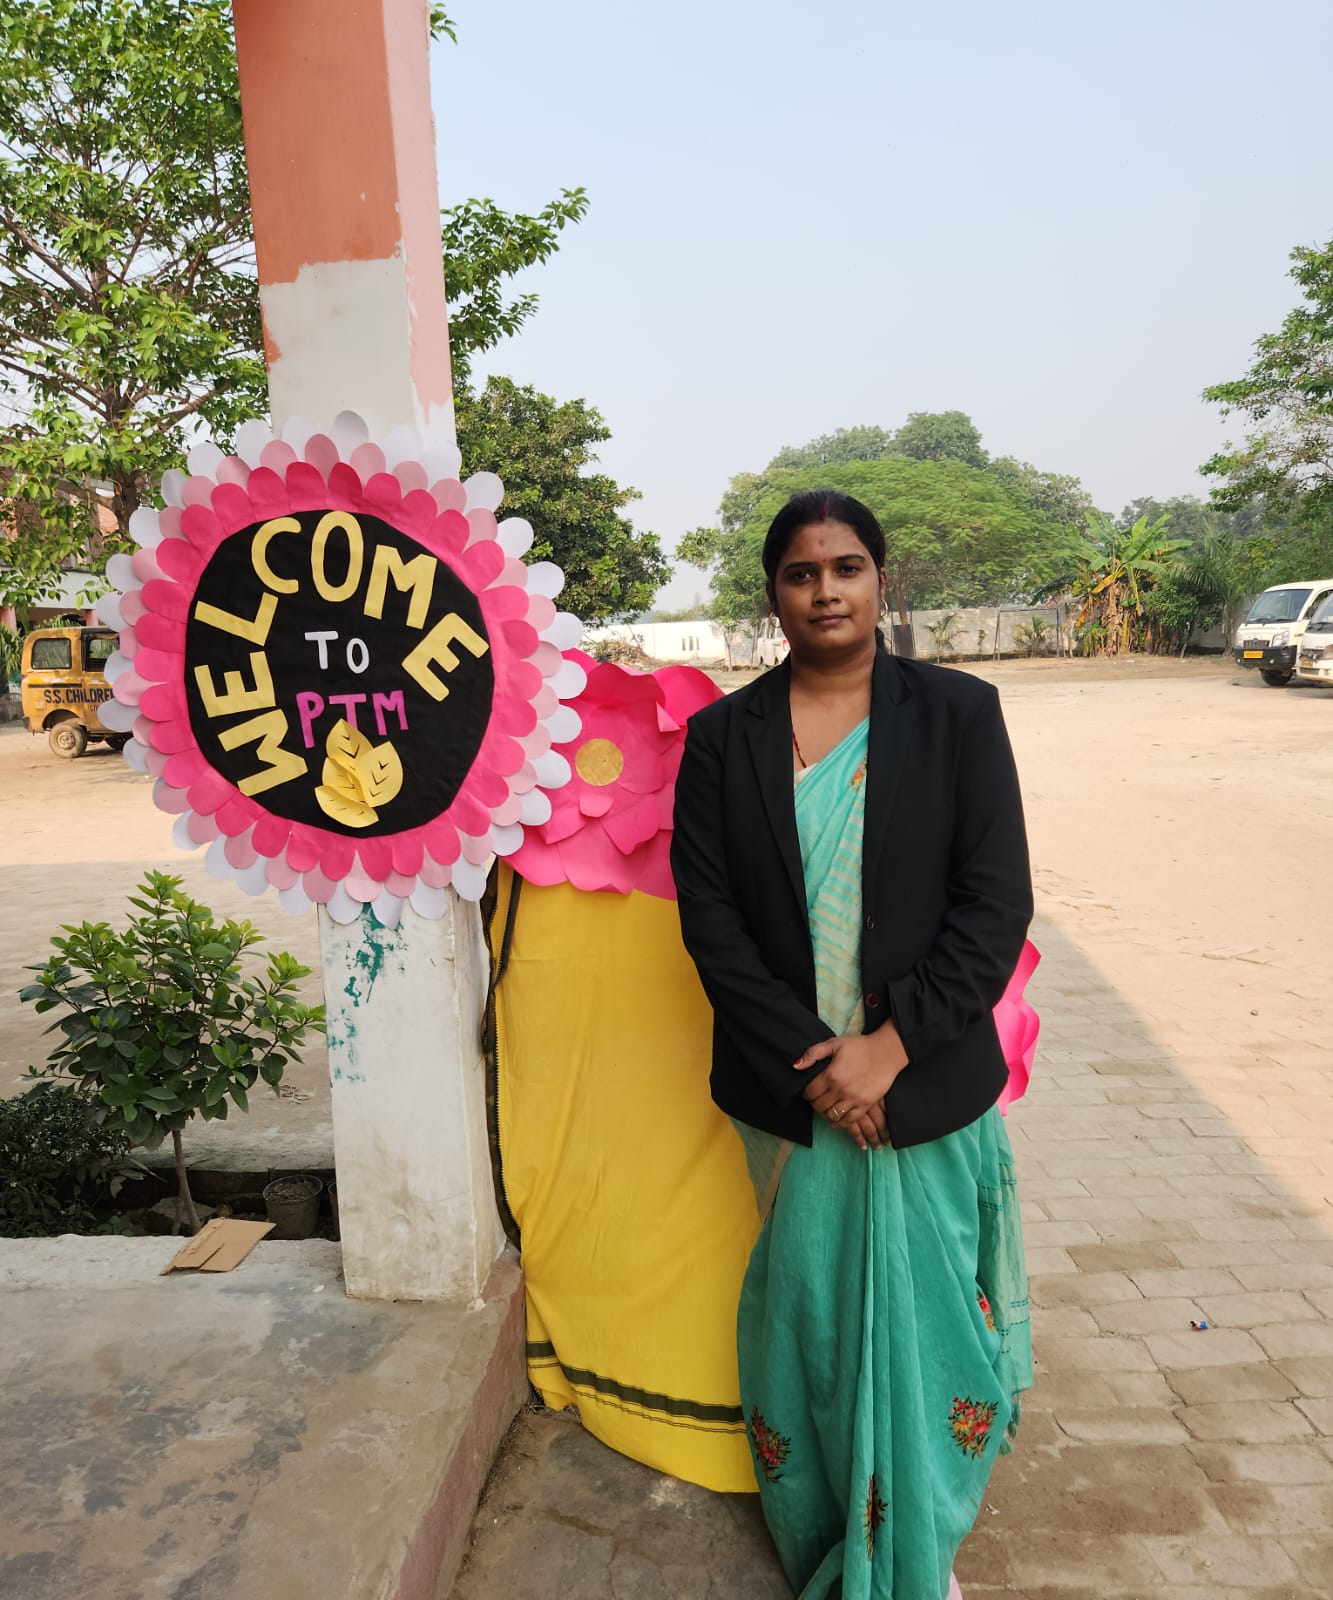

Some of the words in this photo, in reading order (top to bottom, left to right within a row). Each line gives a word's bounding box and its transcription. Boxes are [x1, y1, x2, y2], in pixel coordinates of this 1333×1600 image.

[194, 511, 490, 797] WELCOME
[304, 630, 370, 674] TO
[44, 689, 65, 704] S.S.
[295, 690, 409, 749] PTM
